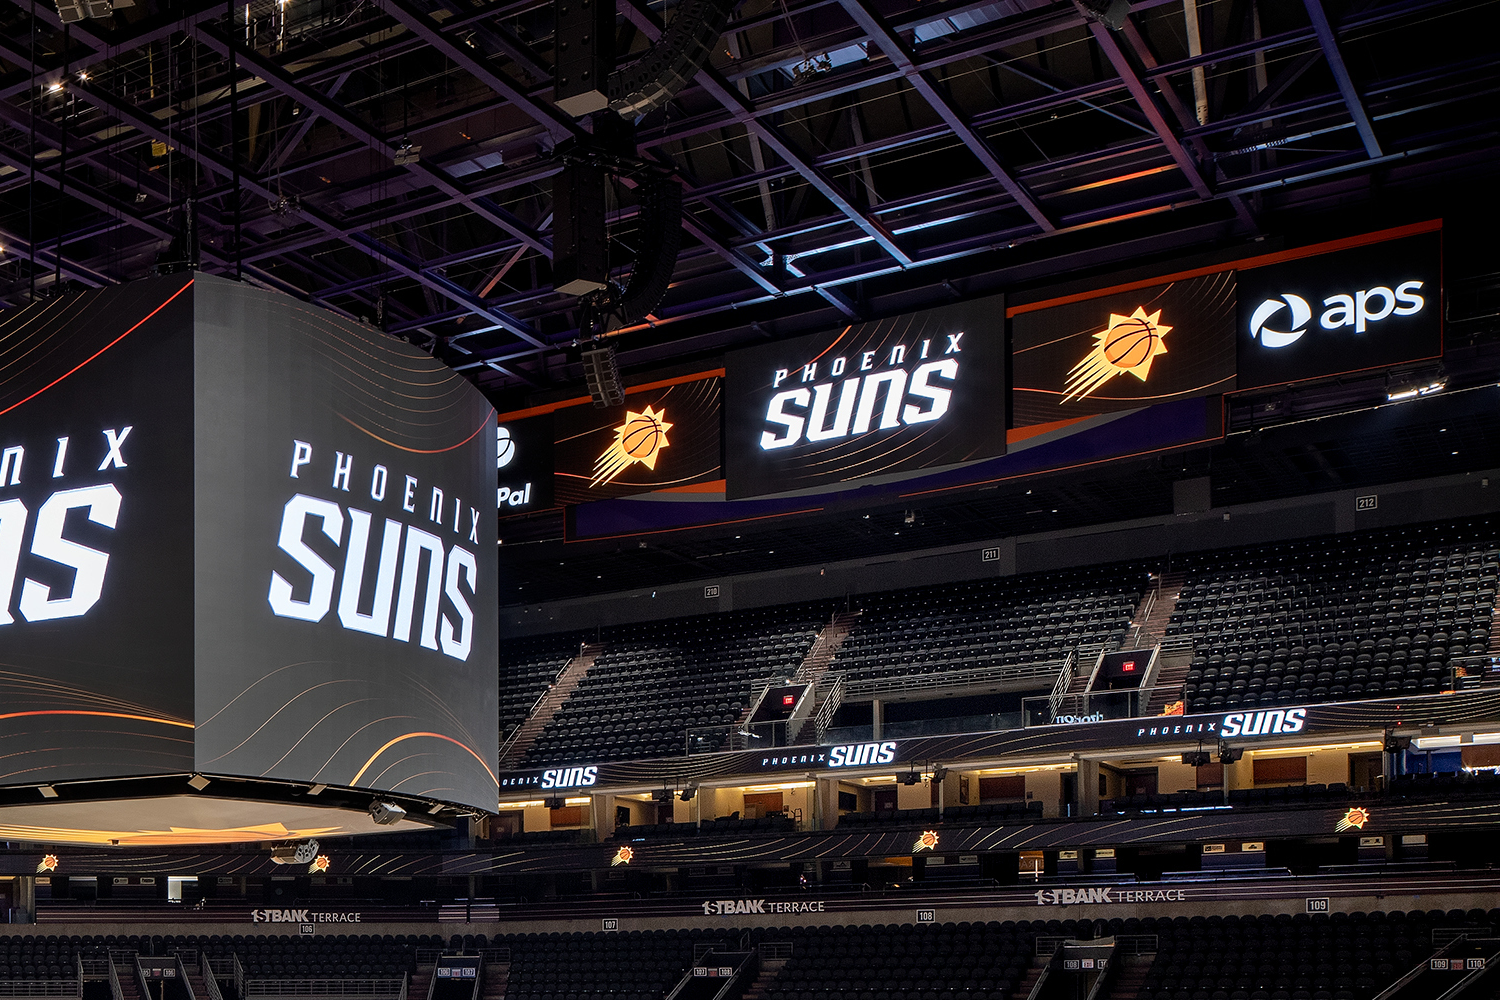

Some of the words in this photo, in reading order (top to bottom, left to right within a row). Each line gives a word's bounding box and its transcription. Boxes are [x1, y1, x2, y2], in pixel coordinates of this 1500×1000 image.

[1319, 281, 1425, 334] aps
[773, 332, 963, 388] PHOENIX
[759, 358, 959, 451] SUNS
[290, 439, 480, 545] PHOENIX
[497, 483, 531, 508] Pal
[267, 492, 477, 661] SUNS
[1138, 722, 1216, 736] PHOENIX
[1220, 709, 1306, 738] SUNS
[762, 754, 824, 766] PHOENIX
[828, 741, 896, 767] SUNS
[502, 777, 539, 786] OENIX
[541, 766, 598, 789] SUNS
[768, 901, 825, 913] TERRACE
[1116, 890, 1186, 903] TERRACE
[1310, 901, 1326, 911] 109
[311, 912, 360, 923] TERRACE
